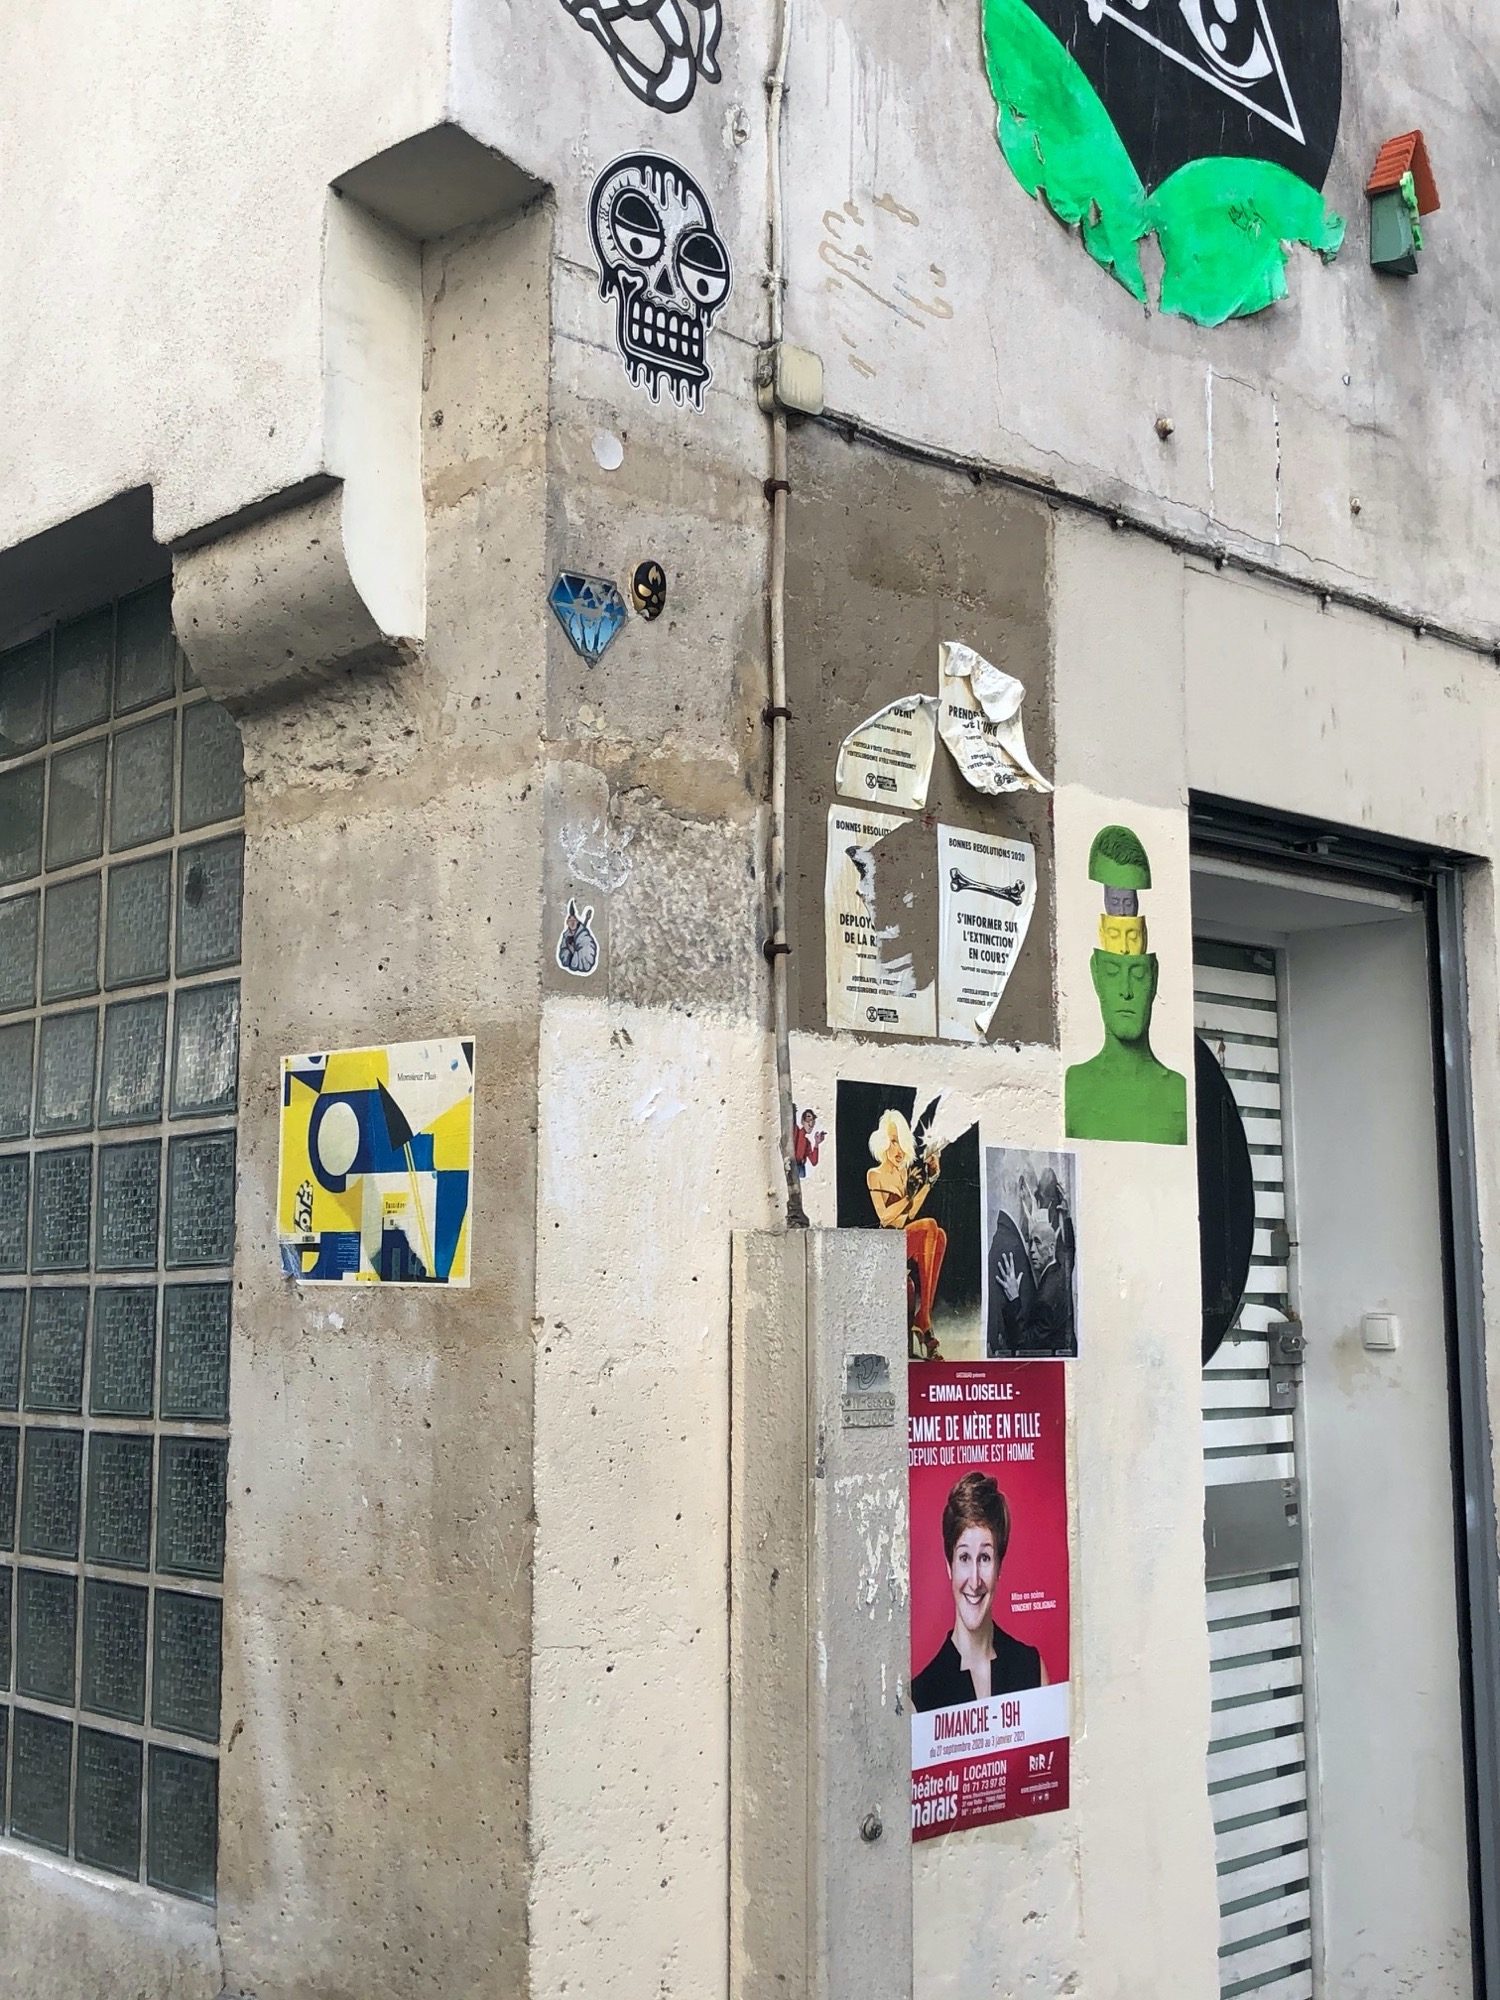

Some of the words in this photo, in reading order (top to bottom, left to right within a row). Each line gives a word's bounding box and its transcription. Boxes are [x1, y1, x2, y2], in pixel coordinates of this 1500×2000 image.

[836, 819, 861, 834] BONNES
[949, 838, 972, 851] BONNES
[973, 843, 1011, 859] RESOLUTIONS
[1011, 851, 1025, 862] 2020
[957, 912, 1002, 931] S'INFORMER
[845, 931, 855, 945] DE
[857, 933, 868, 946] LA
[963, 930, 1014, 949] L'EXTINCTION
[969, 947, 979, 960] EN
[929, 1384, 963, 1402] EMMA
[965, 1383, 1013, 1401] LOISELLE
[945, 1415, 960, 1441] DE
[963, 1410, 993, 1441] MÈRE
[996, 1413, 1011, 1439] EN
[1014, 1412, 1041, 1438] FILLE
[909, 1446, 938, 1467] DEPUIS
[940, 1446, 955, 1467] QUE
[957, 1444, 989, 1464] L'HOMME
[991, 1444, 1004, 1462] EST
[1007, 1442, 1035, 1462] HOMME
[934, 1705, 989, 1741] DIMANCHE
[1001, 1700, 1021, 1728] 19H
[930, 1746, 936, 1758] du
[943, 1741, 971, 1756] septembre
[963, 1759, 1007, 1781] LOCATION
[945, 1770, 959, 1793] du
[962, 1783, 970, 1793] 01
[972, 1781, 979, 1792] 71
[981, 1779, 989, 1790] 73
[990, 1777, 998, 1789] 97
